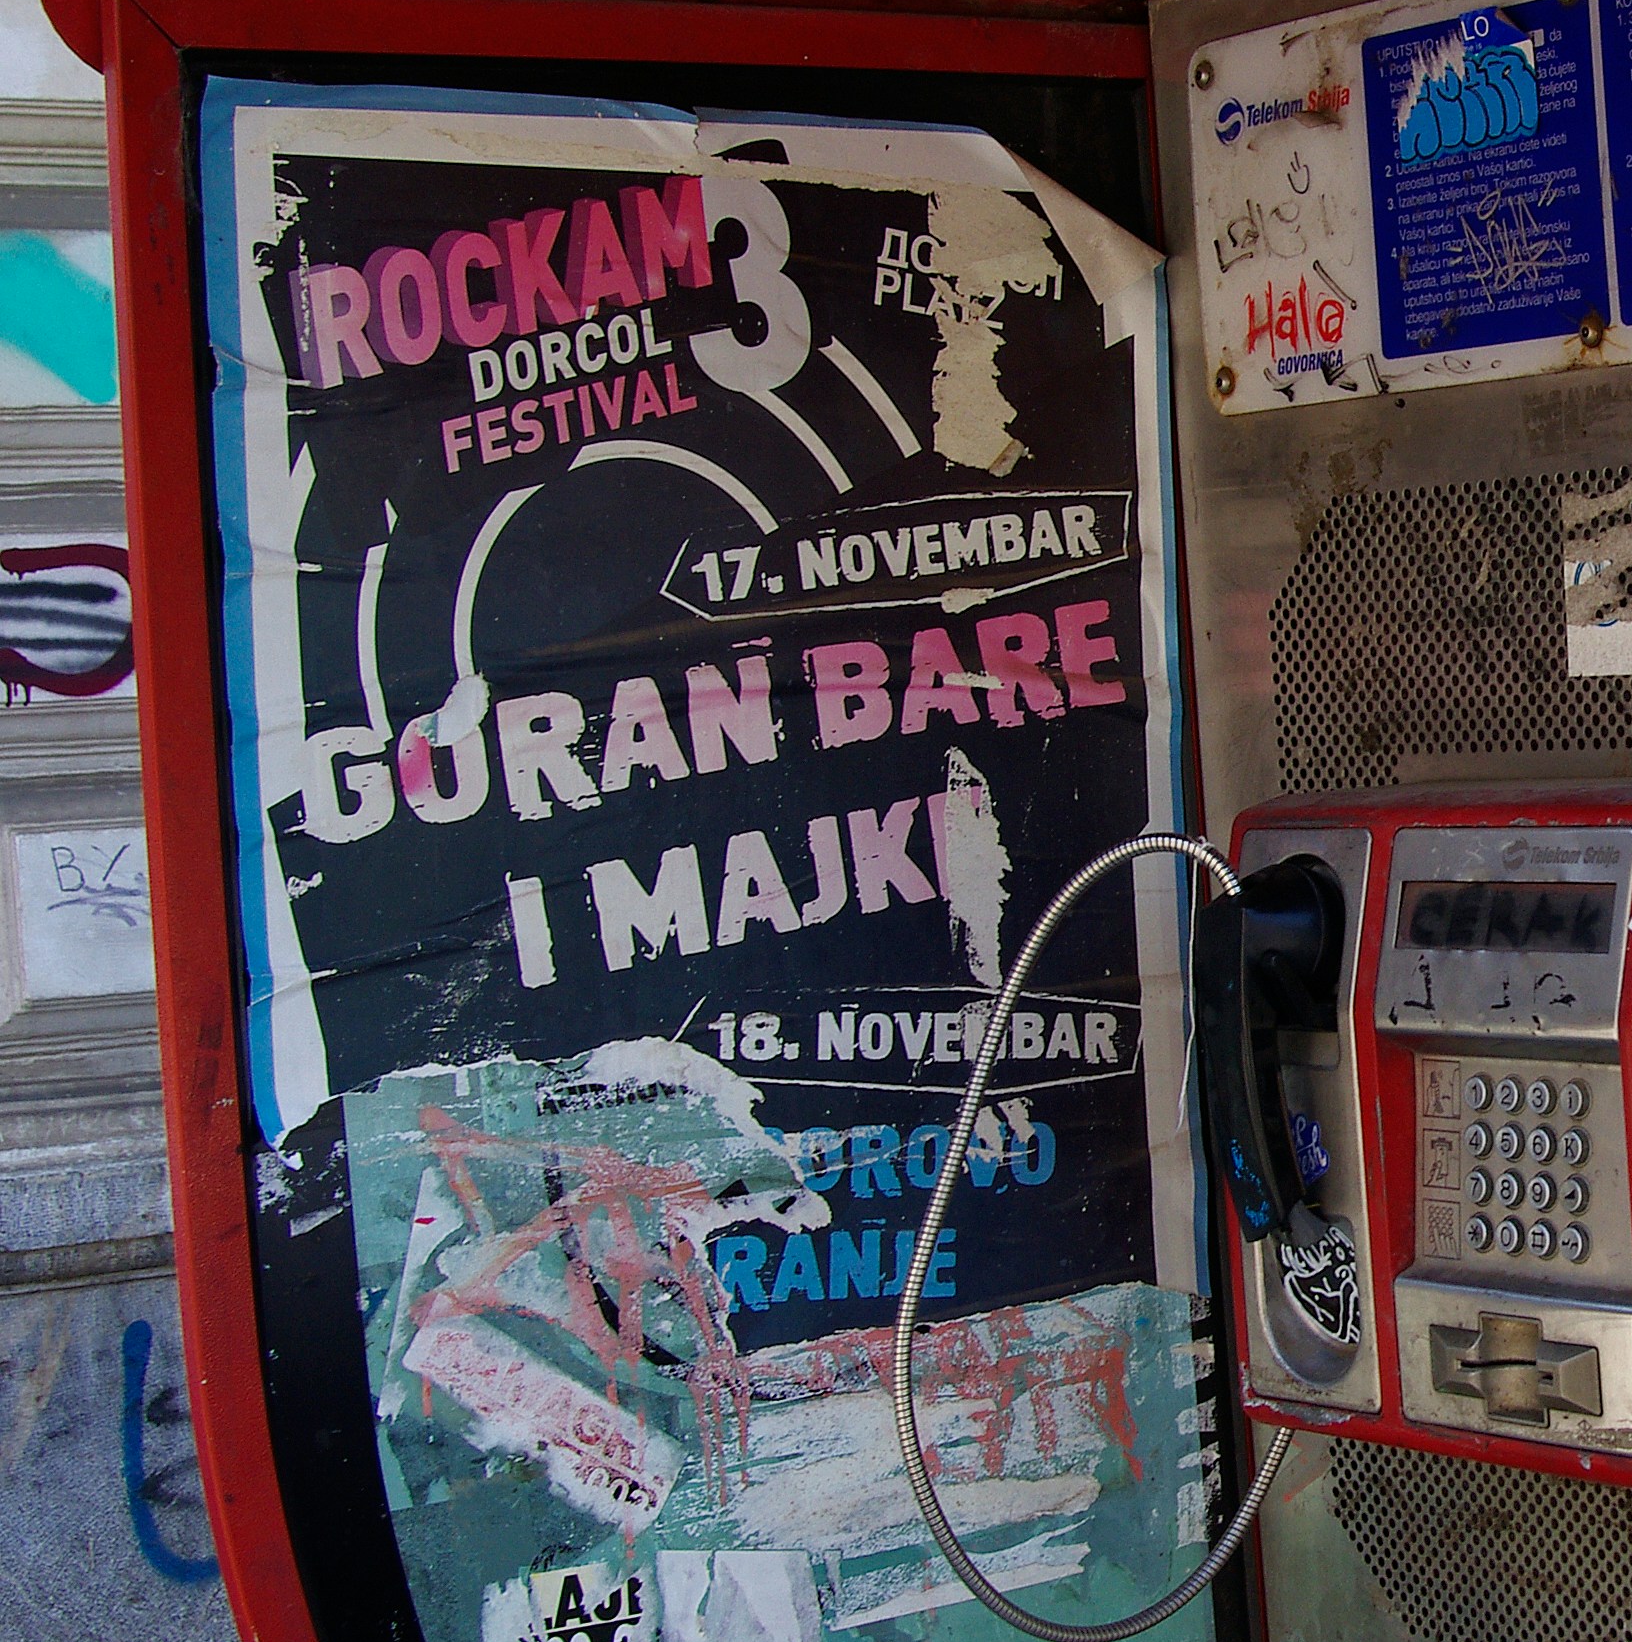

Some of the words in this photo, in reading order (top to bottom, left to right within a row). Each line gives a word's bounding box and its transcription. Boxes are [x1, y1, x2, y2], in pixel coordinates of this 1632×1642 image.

[1246, 97, 1303, 128] Telekom
[288, 175, 713, 389] ROCKAM
[690, 175, 812, 392] 3
[468, 304, 672, 403] DORĆOL
[442, 362, 697, 474] FESTIVAL
[690, 544, 788, 604] 17.
[798, 504, 1102, 591] NOVEMBAR
[300, 637, 784, 844] GORAN
[803, 600, 1127, 751] BARE
[1530, 845, 1580, 865] Telekom
[1583, 845, 1620, 867] Srbija
[505, 871, 556, 988] I
[708, 1012, 800, 1062] 18.
